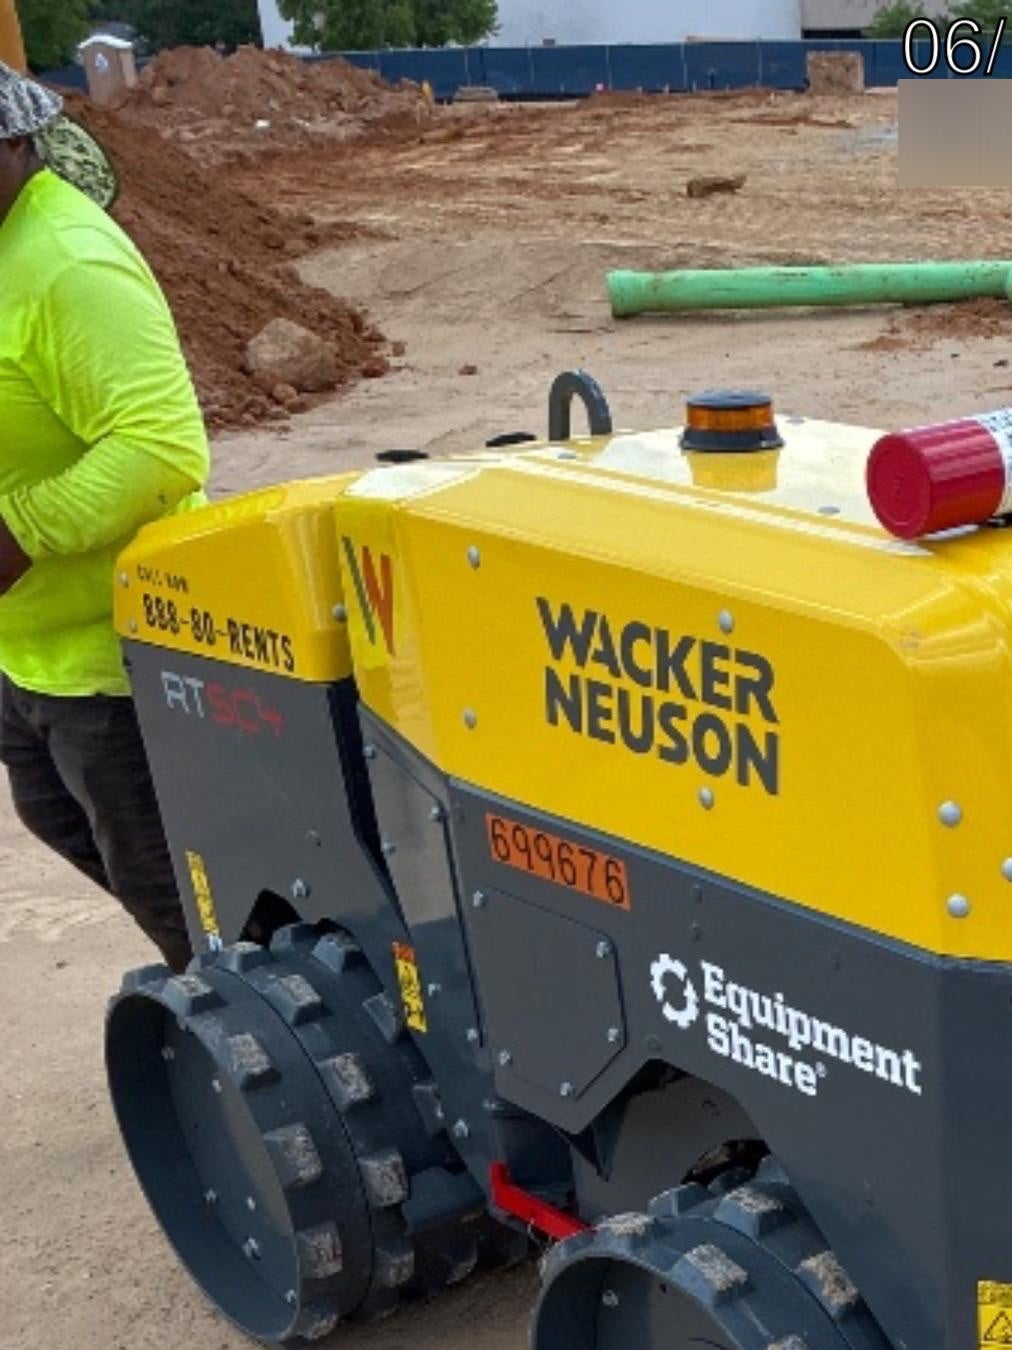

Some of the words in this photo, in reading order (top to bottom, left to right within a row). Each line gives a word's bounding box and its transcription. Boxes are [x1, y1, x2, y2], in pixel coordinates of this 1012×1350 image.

[143, 593, 295, 672] 888-80-RENTS
[535, 596, 779, 724] WACKER
[545, 666, 779, 796] NEUSON
[491, 818, 624, 903] 699676
[700, 959, 922, 1096] Equipment
